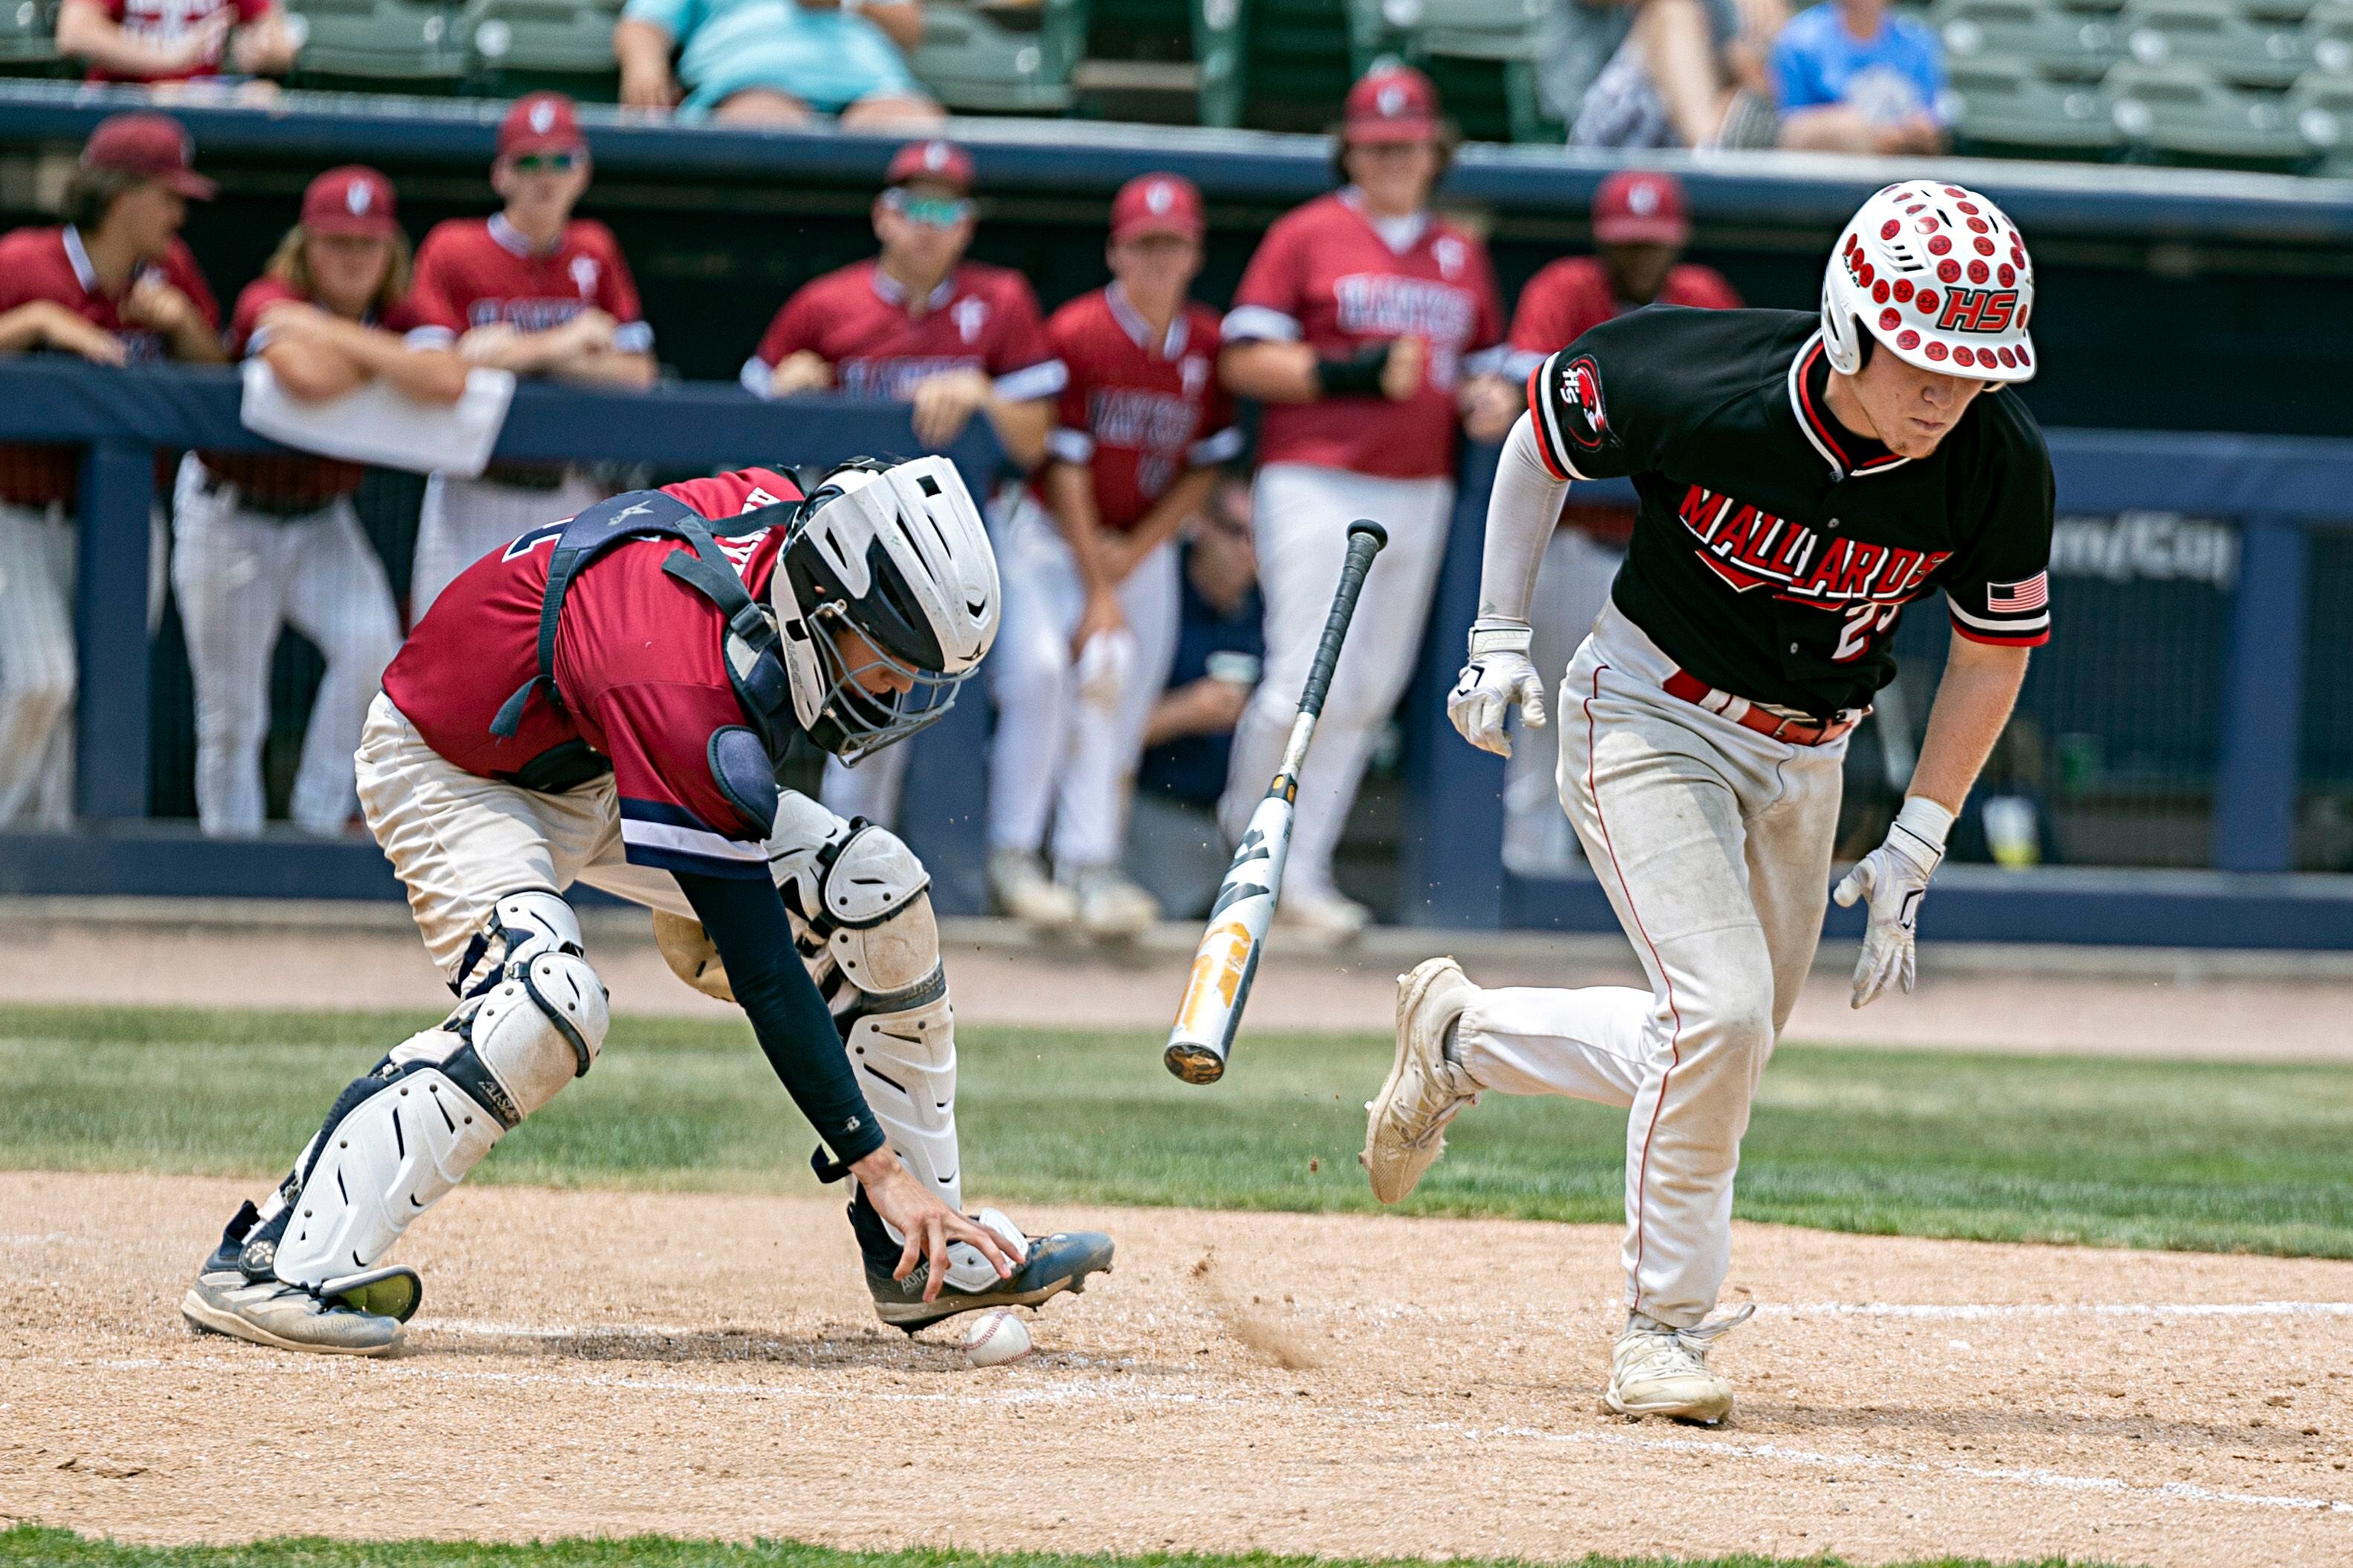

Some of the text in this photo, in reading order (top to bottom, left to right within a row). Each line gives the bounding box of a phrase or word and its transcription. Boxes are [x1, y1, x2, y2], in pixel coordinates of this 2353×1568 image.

[1937, 287, 2019, 333] HS
[1560, 368, 1580, 403] HS
[1678, 484, 1955, 599] MALLARDS
